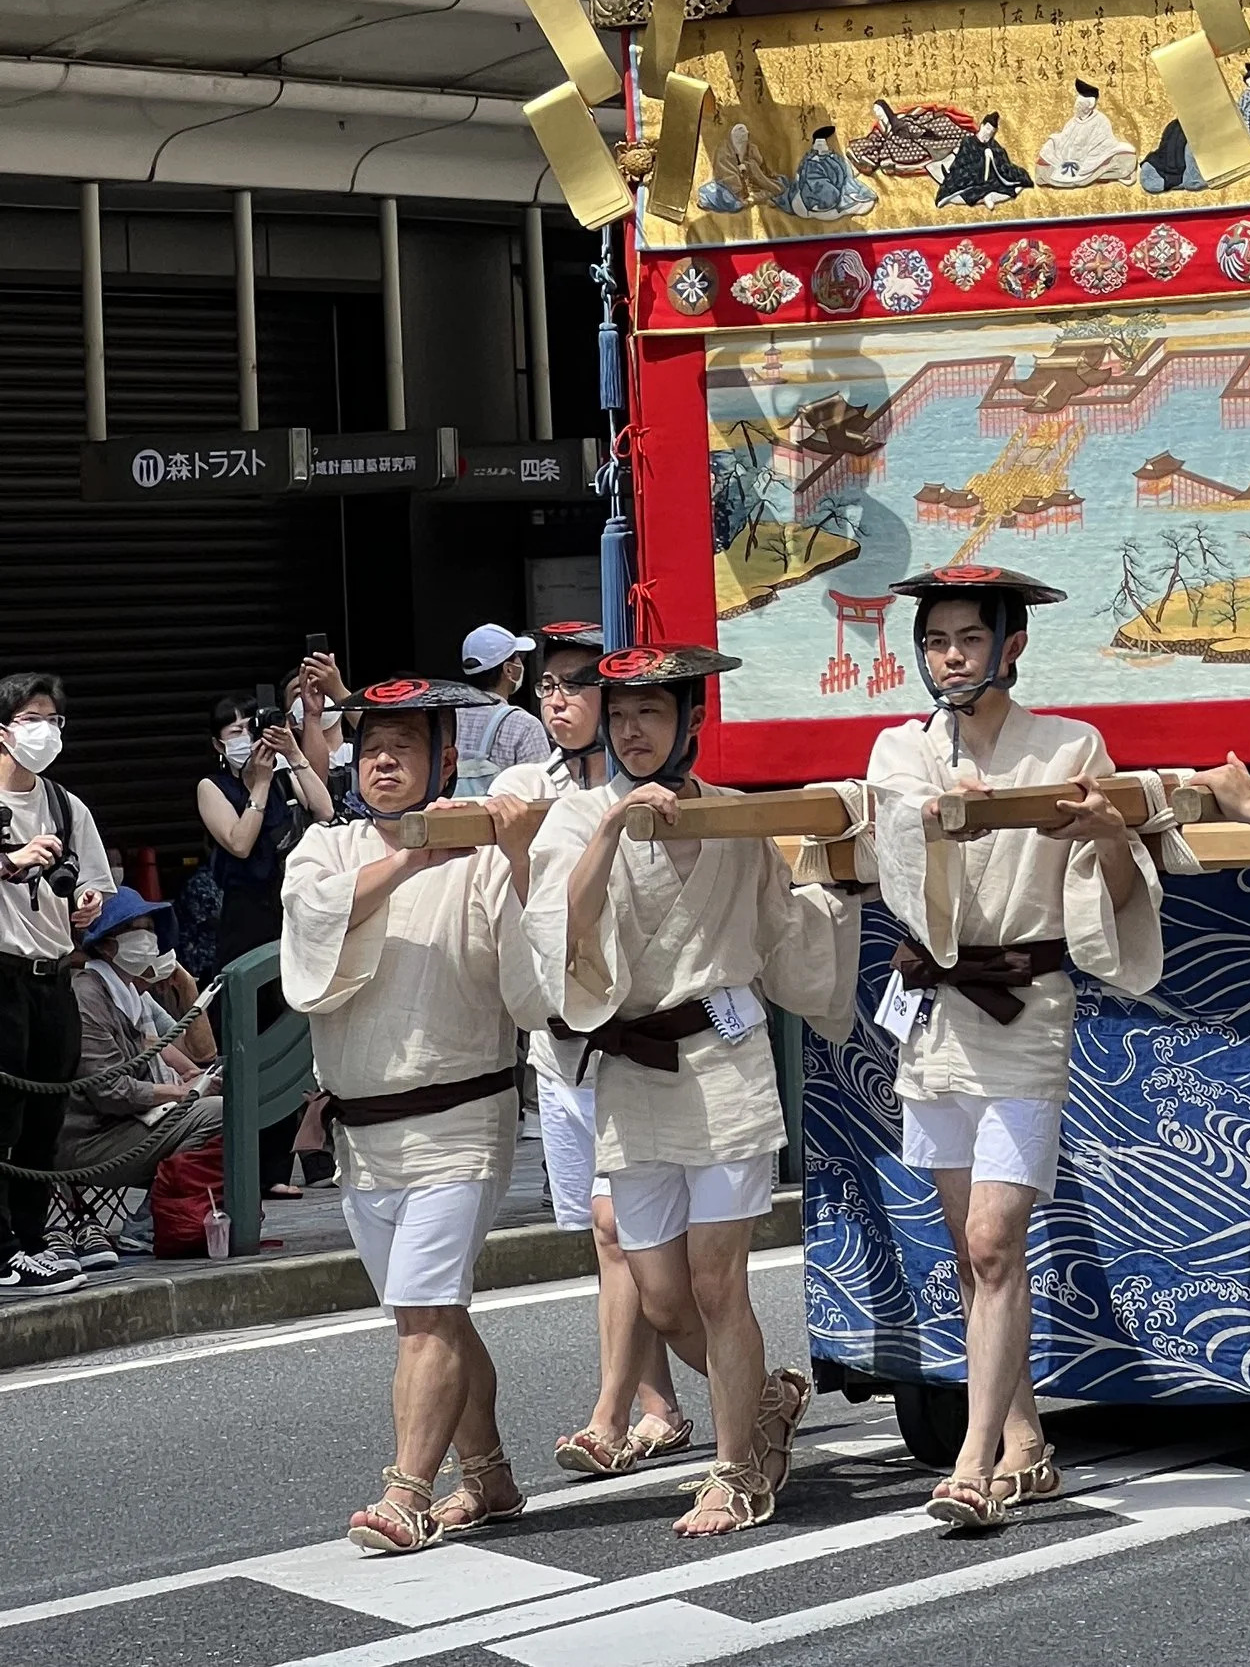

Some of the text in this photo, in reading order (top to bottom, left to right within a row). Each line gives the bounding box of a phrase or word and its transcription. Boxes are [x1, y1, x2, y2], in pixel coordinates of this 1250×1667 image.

[166, 448, 266, 481] 森トラスト
[520, 458, 561, 482] 四条
